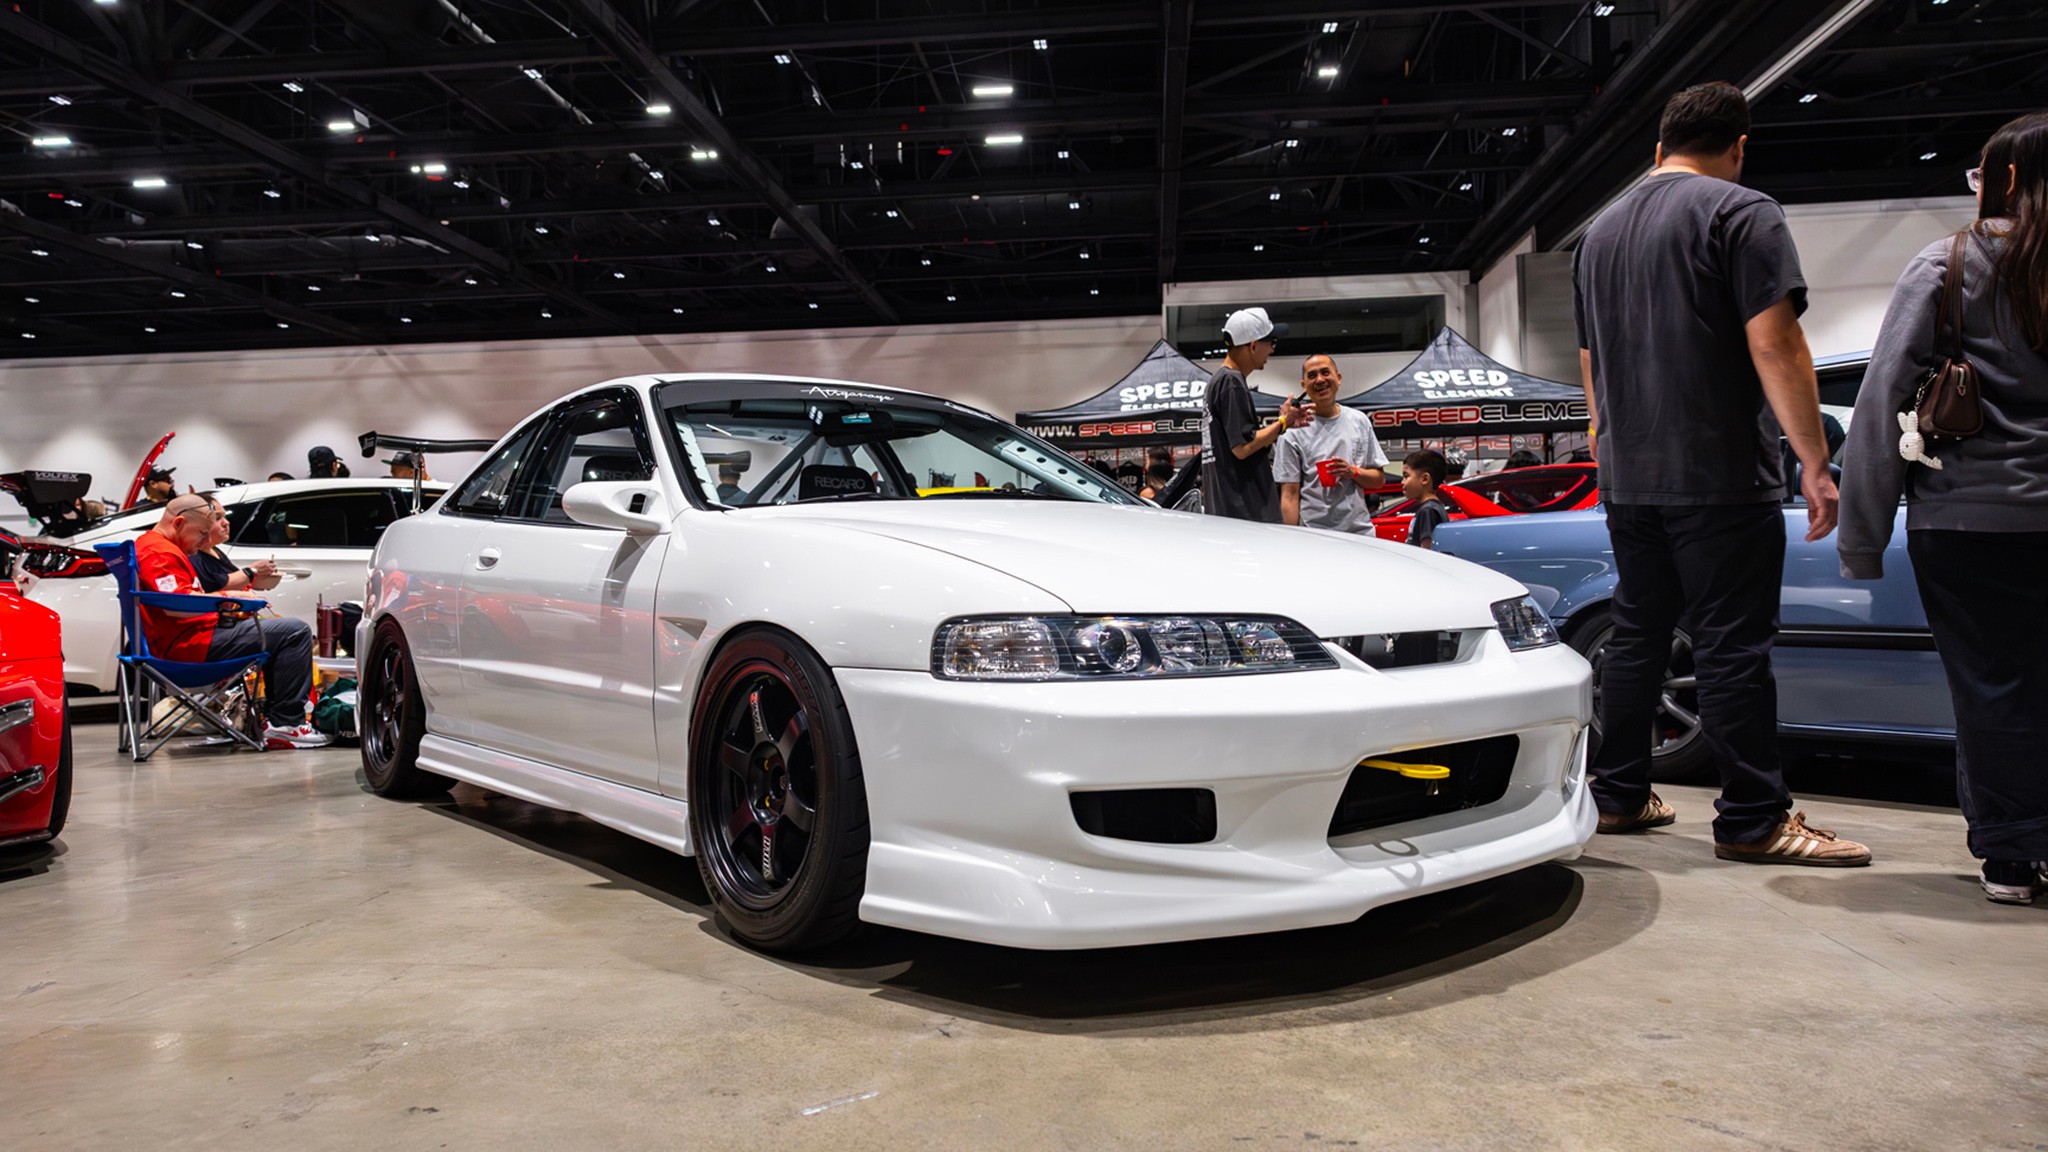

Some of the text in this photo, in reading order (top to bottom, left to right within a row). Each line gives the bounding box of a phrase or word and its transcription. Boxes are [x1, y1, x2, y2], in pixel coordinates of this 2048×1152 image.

[1413, 370, 1509, 388] SPEED
[1119, 381, 1207, 402] SPEED
[1423, 387, 1515, 399] ELEMENT
[1120, 399, 1204, 411] ELEMENT
[1371, 401, 1590, 427] SPEEDELEME
[35, 472, 77, 480] VOLTEX
[814, 476, 866, 490] RECARO
